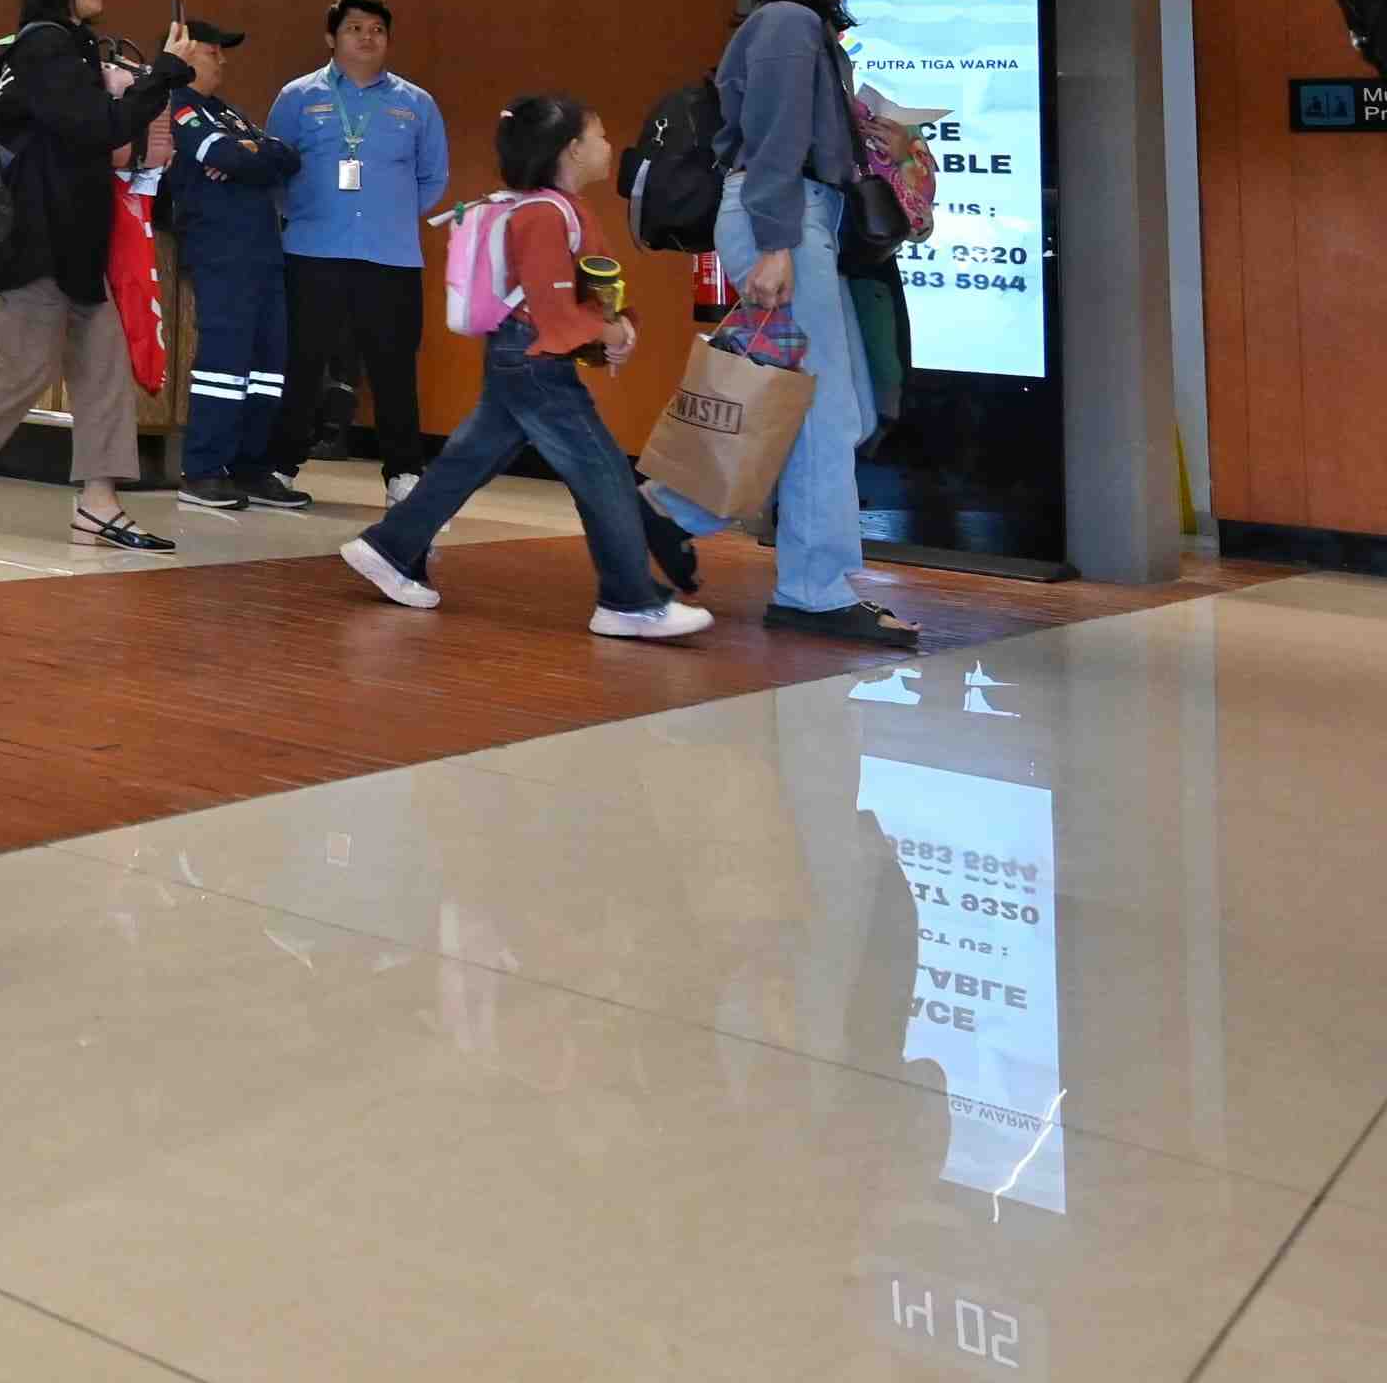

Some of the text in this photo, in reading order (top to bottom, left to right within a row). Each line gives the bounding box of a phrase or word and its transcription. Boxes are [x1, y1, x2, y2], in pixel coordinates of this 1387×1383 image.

[866, 59, 916, 70] PUTRA
[920, 59, 955, 70] TIGA
[959, 59, 1019, 70] WARNA
[1363, 87, 1387, 102] M
[921, 121, 961, 142] CE
[955, 272, 1028, 293] 5944
